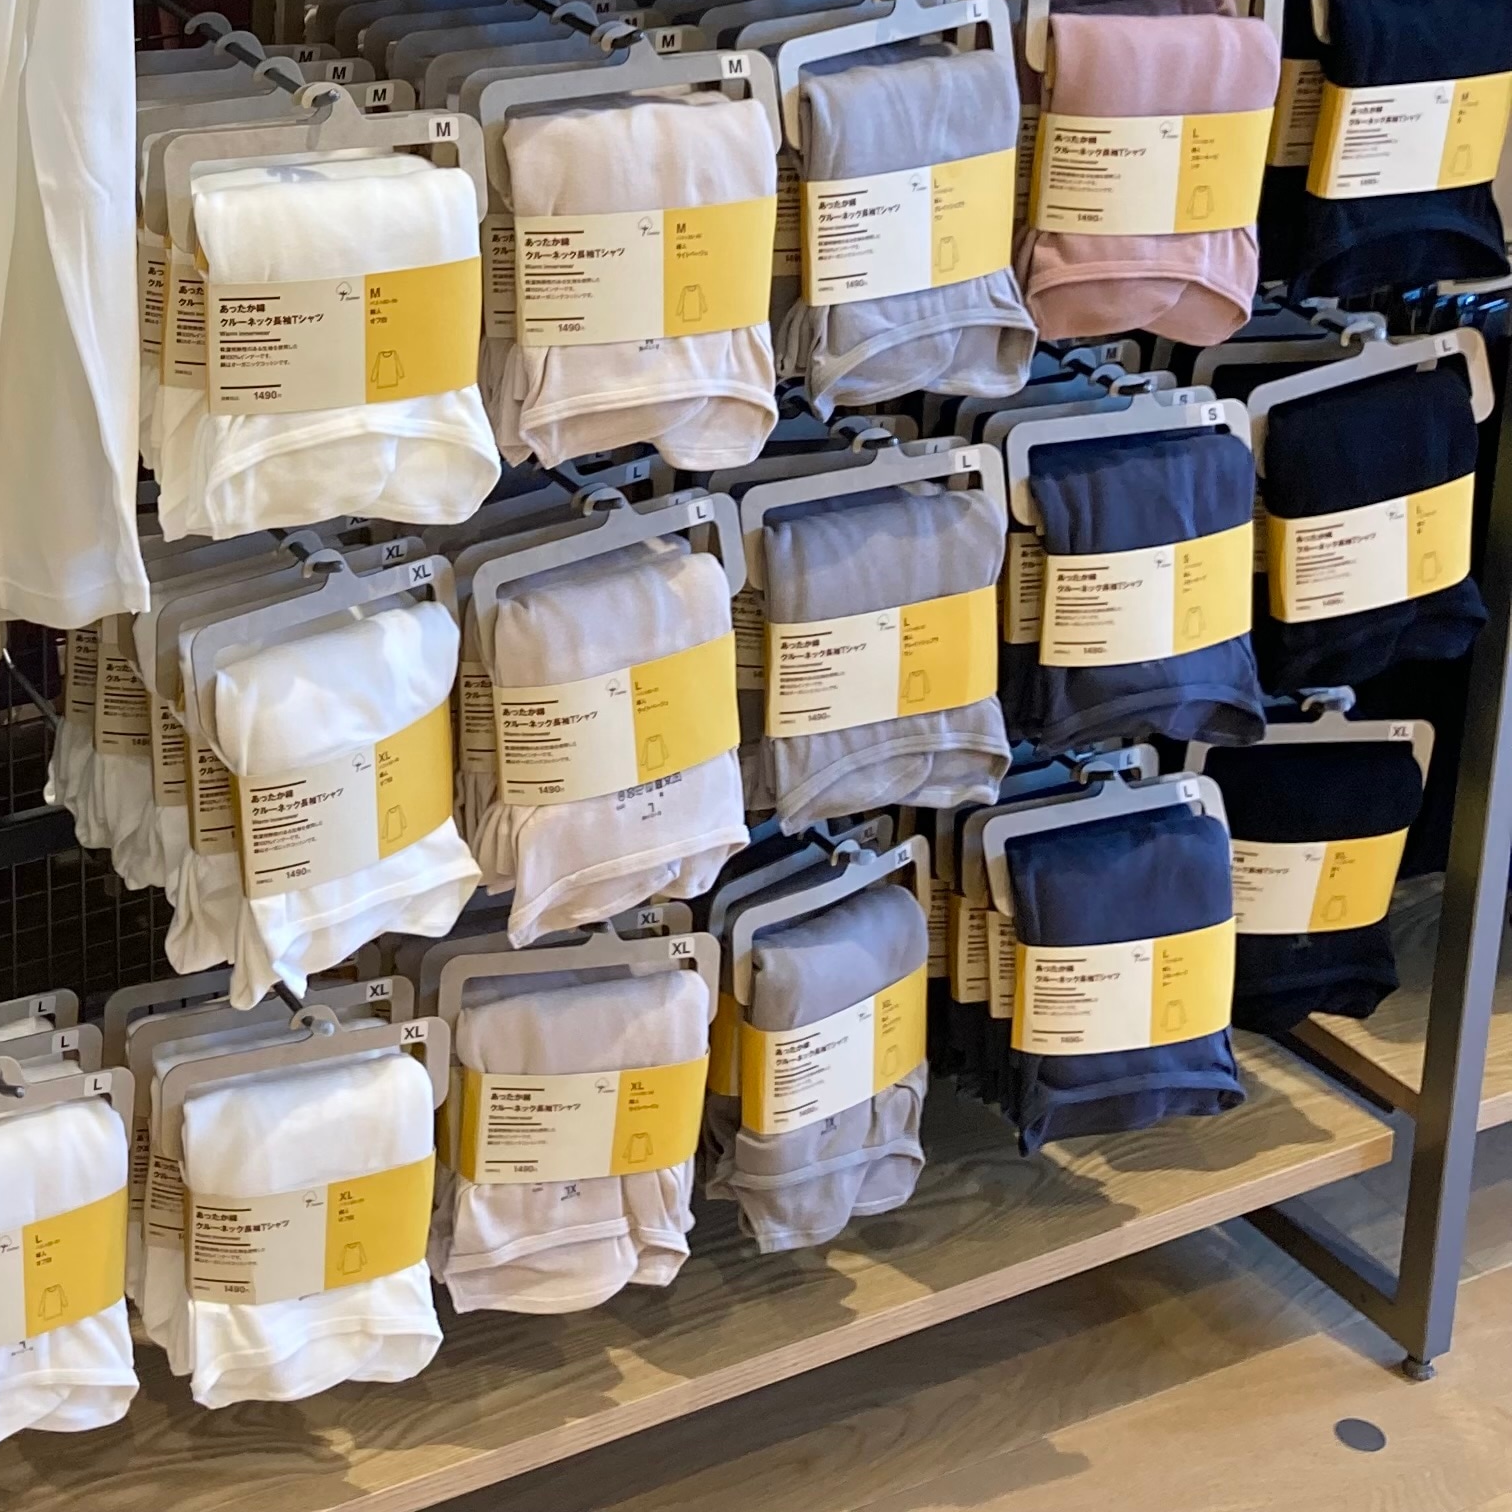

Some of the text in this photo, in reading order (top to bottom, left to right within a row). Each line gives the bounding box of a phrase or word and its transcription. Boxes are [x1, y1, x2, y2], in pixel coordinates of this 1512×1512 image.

[973, 4, 981, 17] L
[662, 35, 675, 48] M
[298, 50, 313, 62] M
[729, 59, 742, 73] M
[333, 67, 346, 79] M
[373, 88, 386, 102] M
[437, 122, 450, 136] M
[676, 223, 687, 233] M
[370, 288, 381, 298] M
[219, 304, 266, 314] あったか綿
[219, 313, 324, 327] クルーネック長袖Tシャツ
[1443, 340, 1452, 351] L
[1179, 394, 1188, 405] S
[1208, 408, 1218, 421] S
[962, 455, 970, 468] L
[633, 467, 642, 479] L
[696, 507, 706, 519] L
[385, 545, 405, 558] XL
[412, 565, 431, 580] XL
[1393, 726, 1408, 738] XL
[378, 751, 391, 764] XL
[1126, 753, 1134, 765] L
[1183, 786, 1192, 798] L
[897, 850, 910, 864] XL
[640, 911, 660, 925] XL
[671, 941, 691, 955] XL
[369, 984, 389, 997] XL
[38, 1001, 46, 1013] L
[404, 1026, 424, 1039] XL
[61, 1035, 69, 1048] L
[93, 1078, 102, 1090] L
[630, 1081, 644, 1091] XL
[339, 1191, 353, 1201] XL
[35, 1235, 42, 1244] L
